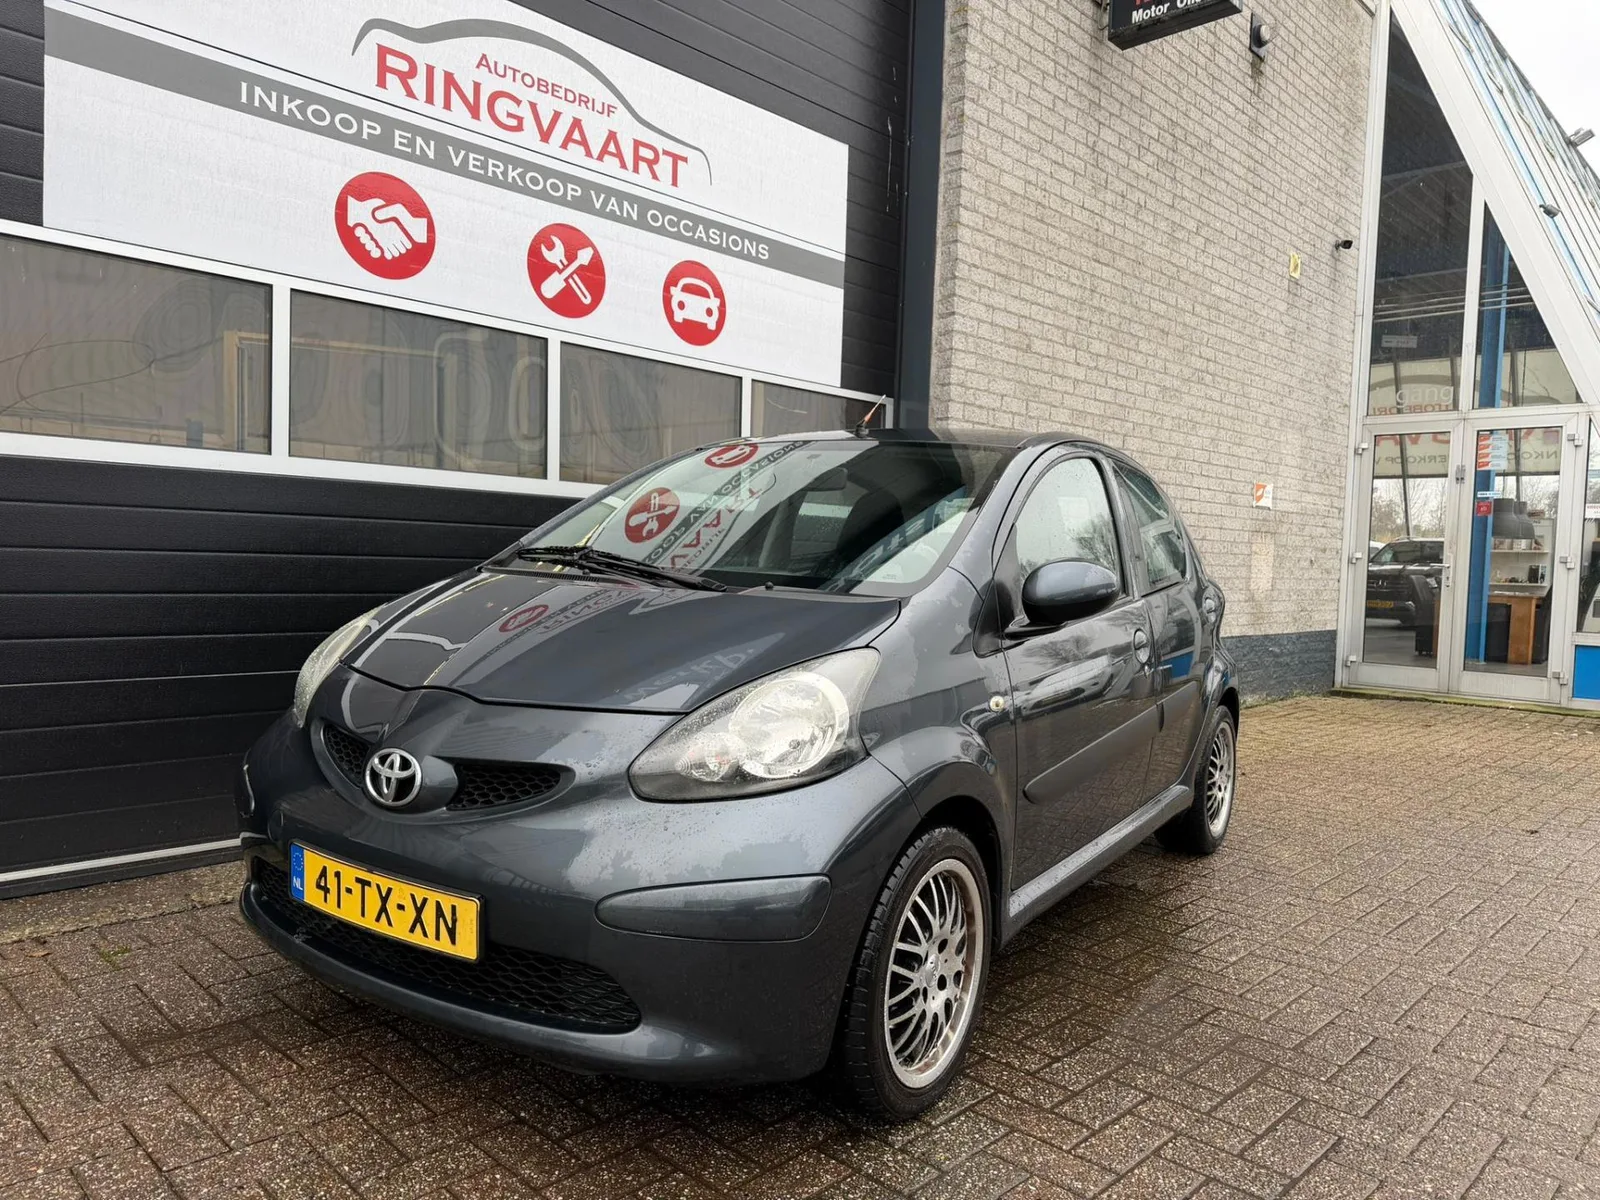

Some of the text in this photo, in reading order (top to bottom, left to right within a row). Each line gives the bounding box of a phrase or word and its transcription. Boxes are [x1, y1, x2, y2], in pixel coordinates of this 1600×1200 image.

[1131, 2, 1170, 24] Motor
[376, 43, 689, 188] RINGVAART
[475, 53, 618, 119] AUTOBEDRIJF
[240, 81, 770, 260] INKOOP EN VERKOOP VAN OCCASIONS
[292, 875, 304, 891] NL
[315, 864, 458, 946] 41-TX-XN
